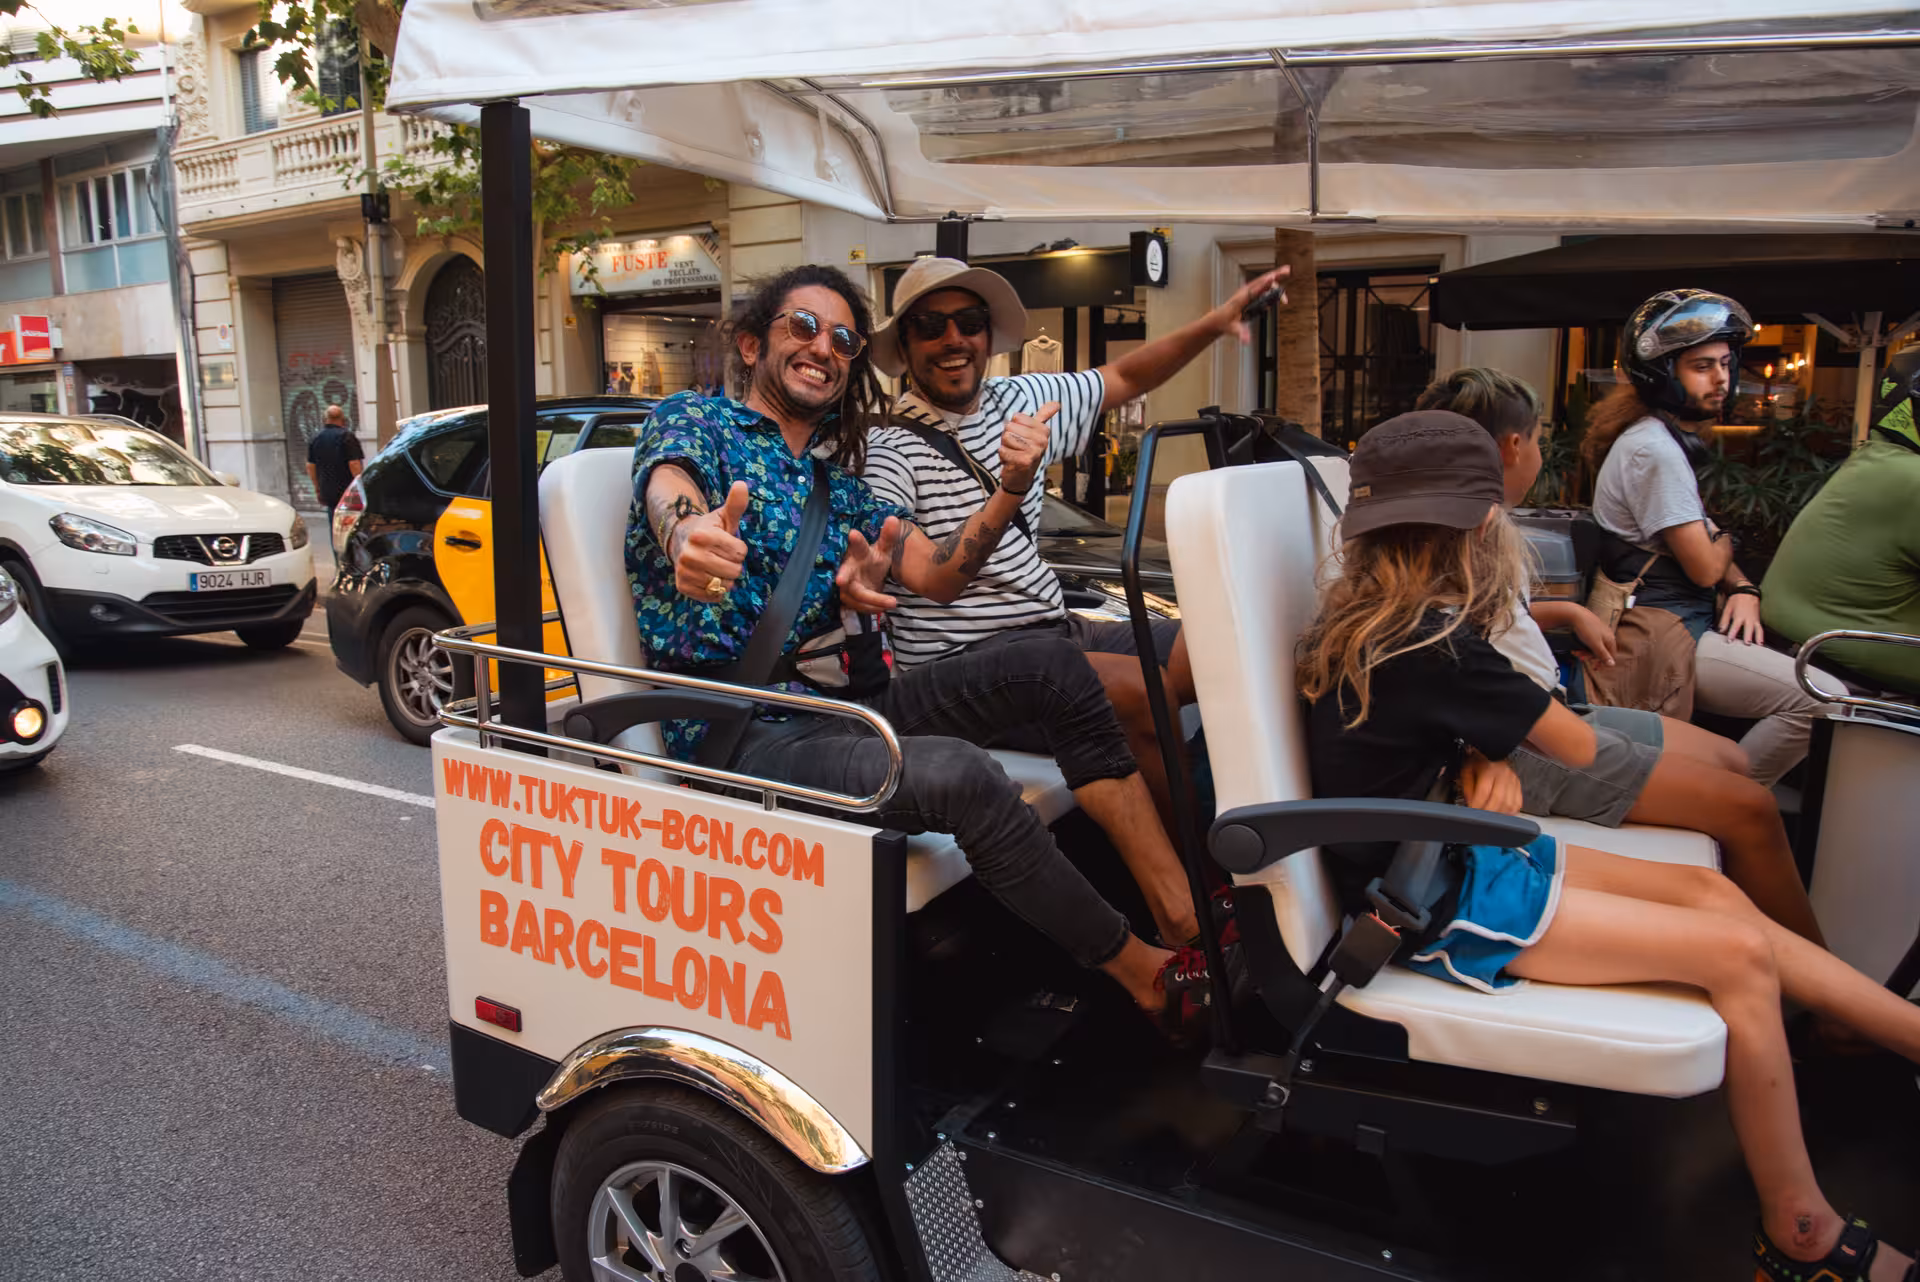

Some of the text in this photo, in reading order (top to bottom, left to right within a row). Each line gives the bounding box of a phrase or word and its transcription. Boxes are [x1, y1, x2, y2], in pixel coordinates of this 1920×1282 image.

[611, 251, 669, 273] FUSTE
[200, 572, 265, 588] 9024 HJR
[443, 758, 825, 888] WWW.TUKTUK-BCN.COM
[480, 818, 783, 954] CITY TOURS
[480, 889, 792, 1041] BARCELONA
